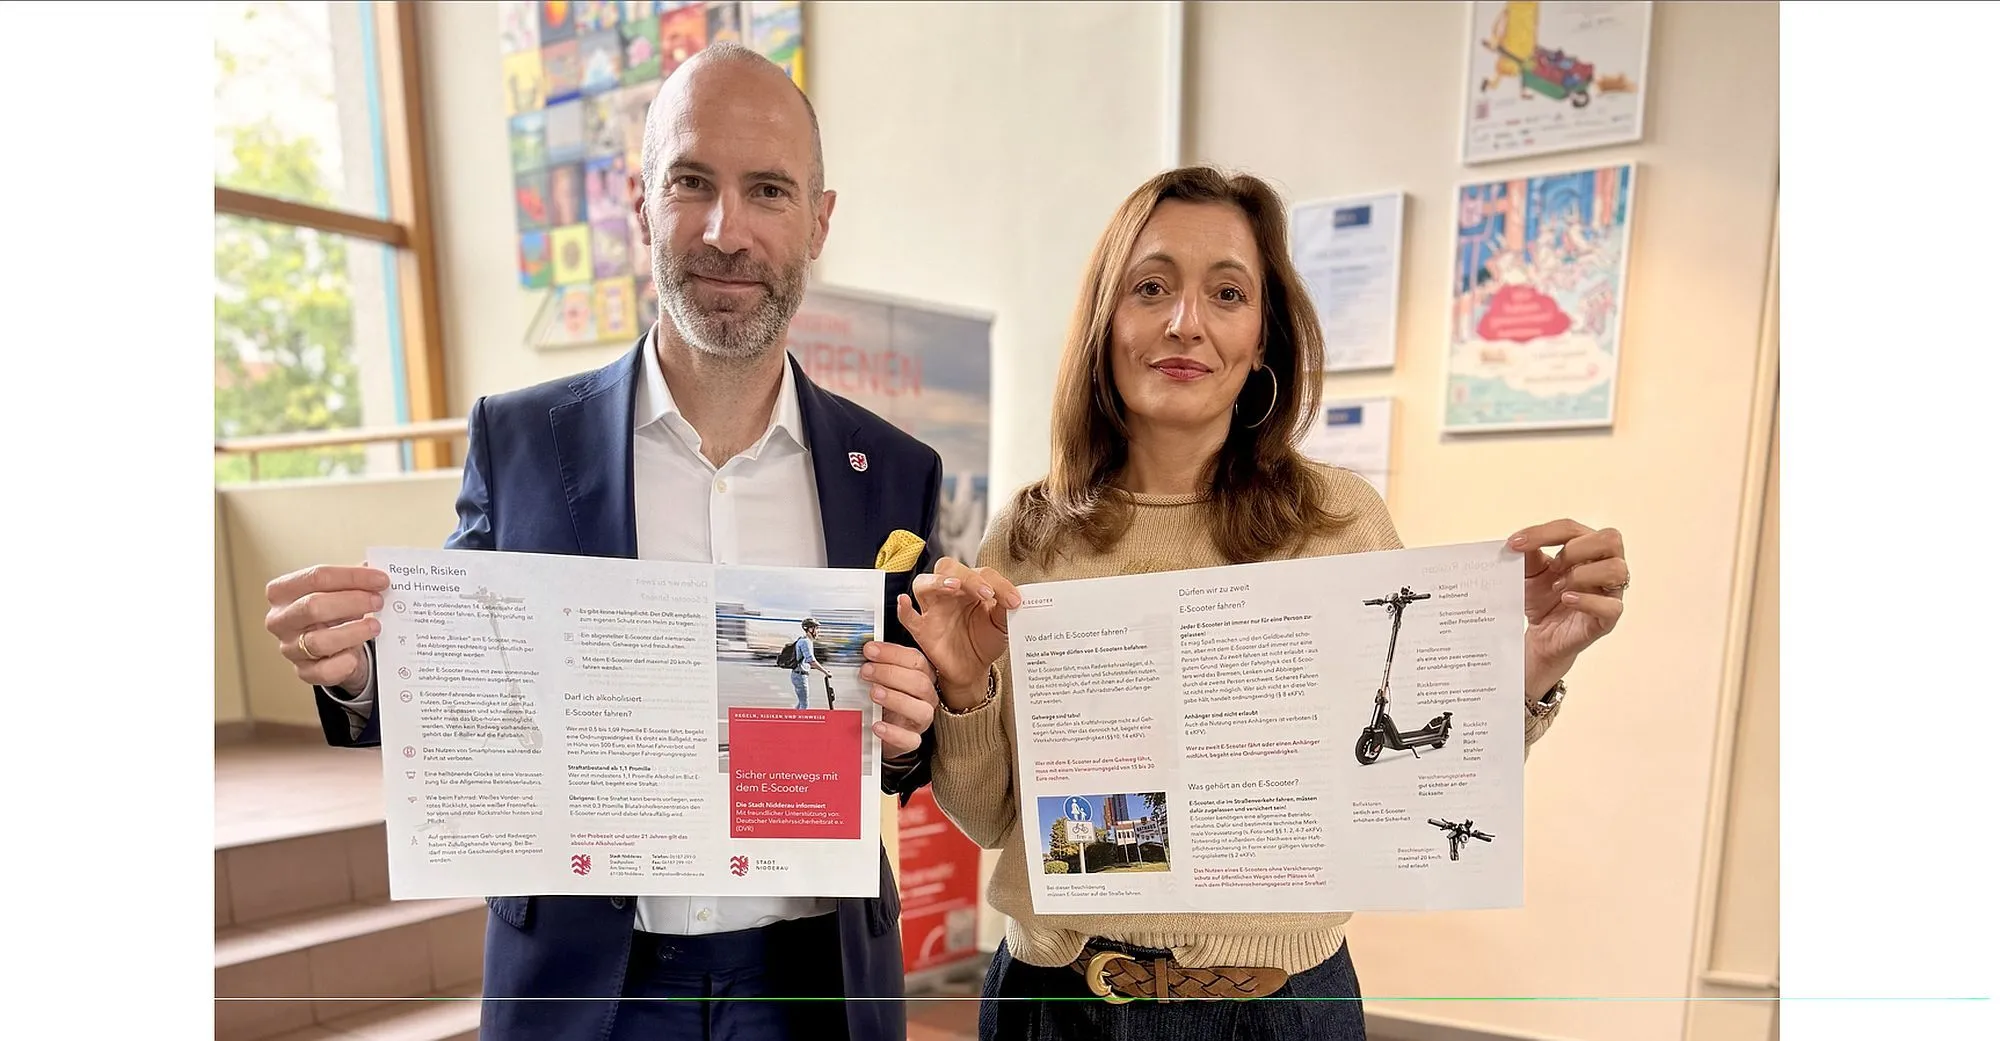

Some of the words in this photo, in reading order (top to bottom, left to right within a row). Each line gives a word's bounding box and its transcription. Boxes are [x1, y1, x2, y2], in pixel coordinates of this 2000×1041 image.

[389, 564, 428, 577] Regeln,
[430, 566, 467, 576] Risiken
[391, 582, 411, 590] und
[414, 582, 460, 592] Hinweise
[1178, 587, 1205, 596] Dürfen
[1206, 586, 1218, 594] wir
[1230, 583, 1250, 592] zweit
[1179, 603, 1216, 613] E-Scooter
[1217, 600, 1246, 610] fahren?
[1196, 620, 1223, 628] E-Scooter
[1025, 634, 1037, 642] Wo
[1038, 633, 1052, 641] darf
[1053, 632, 1064, 640] ich
[1065, 629, 1100, 639] E-Scooter
[1101, 627, 1128, 636] fahren?
[596, 694, 642, 702] alkoholisiert
[565, 708, 602, 716] E-Scooter
[604, 709, 632, 717] fahren?
[1184, 712, 1210, 720] Anhänger
[736, 770, 766, 779] Sicher
[769, 771, 820, 782] unterwegs
[822, 771, 838, 780] mit
[736, 783, 759, 792] dem
[761, 783, 808, 793] E-Scooter
[1187, 782, 1204, 790] Was
[1205, 781, 1230, 791] gehört
[1242, 780, 1257, 788] den
[1258, 779, 1298, 788] E-Scooter?
